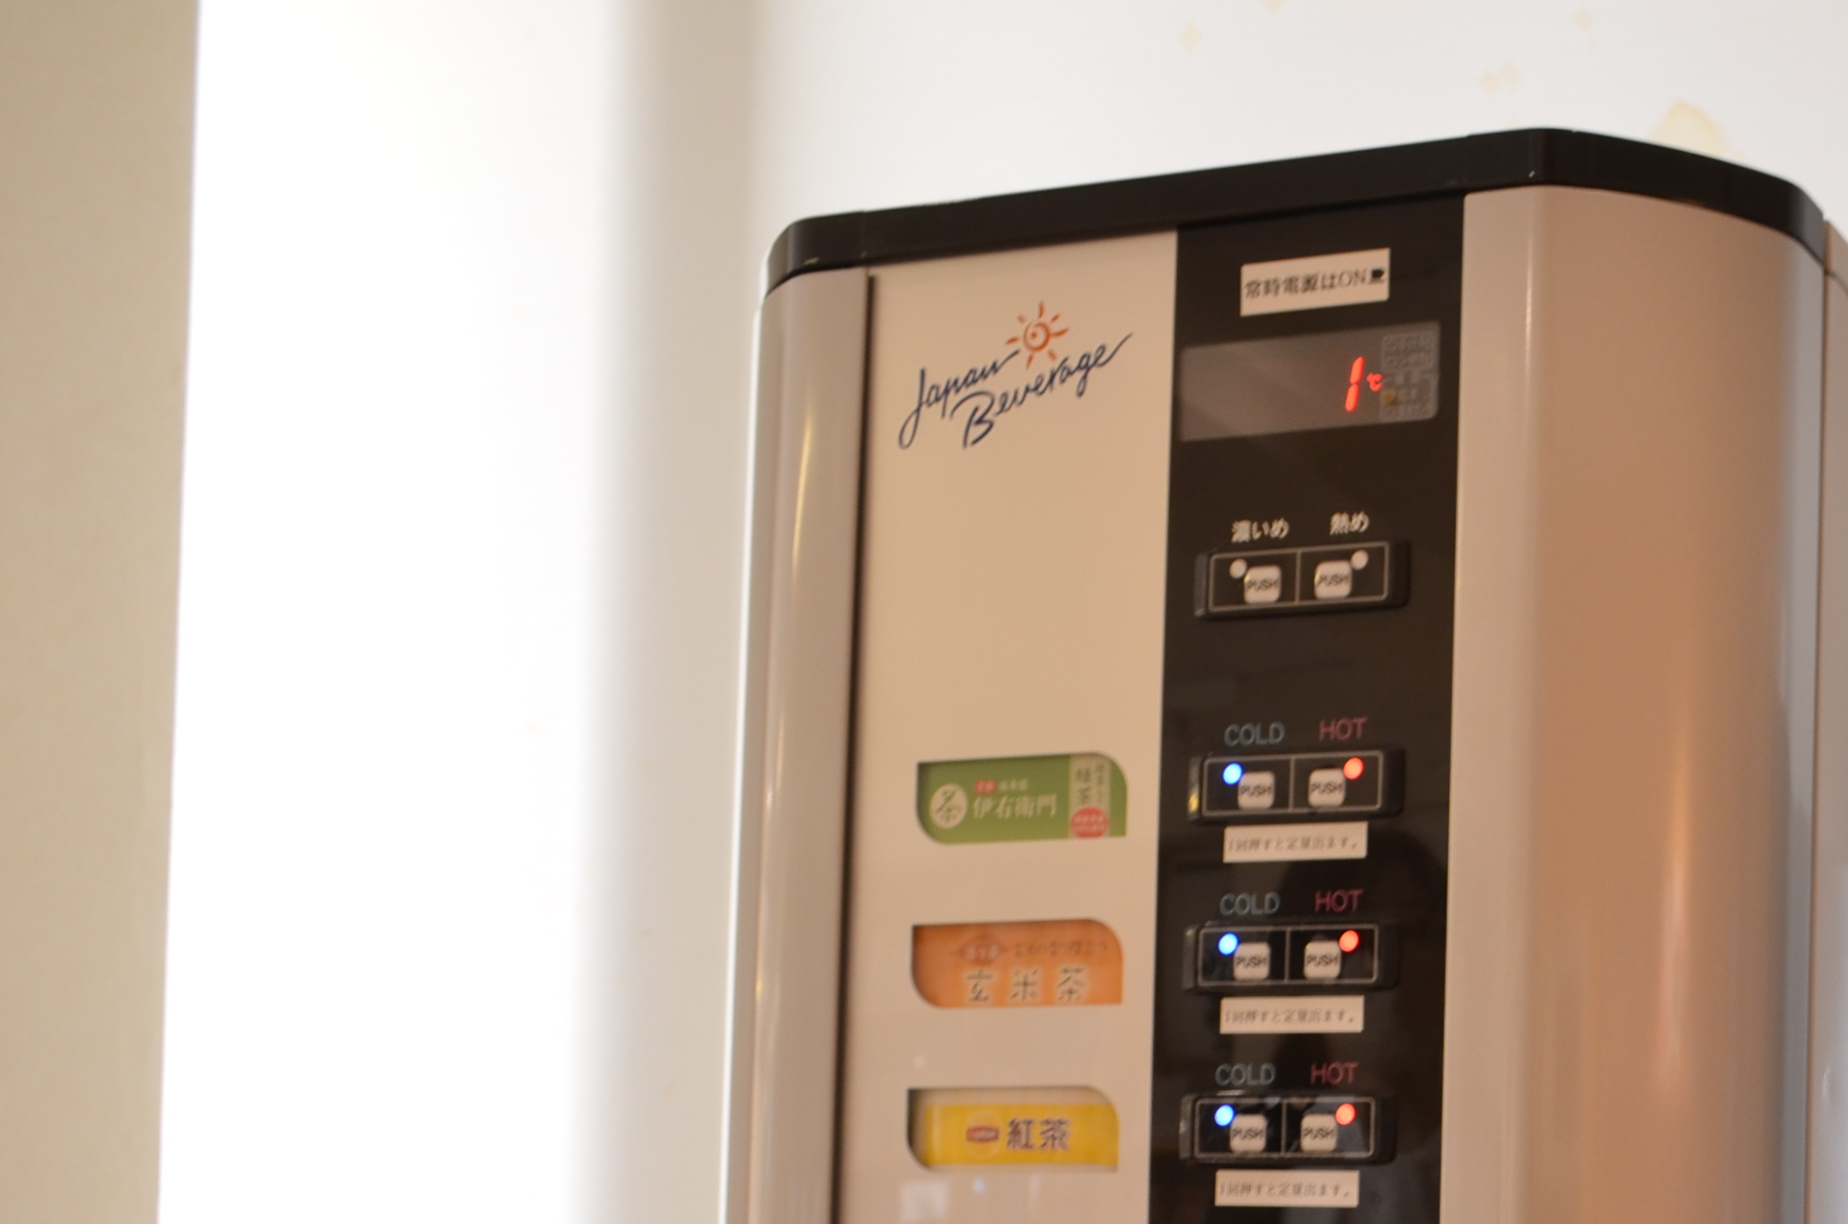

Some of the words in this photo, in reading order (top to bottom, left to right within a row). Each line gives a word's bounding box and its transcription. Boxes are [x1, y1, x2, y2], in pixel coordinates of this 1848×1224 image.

[950, 332, 1133, 449] Beverage
[899, 367, 1019, 449] Japan
[1224, 722, 1285, 746] COLD
[1319, 717, 1367, 741] HOT
[1240, 784, 1272, 796] PUSH
[1311, 782, 1342, 794] PUSH
[1219, 892, 1281, 916] COLD
[1314, 889, 1364, 912] HOT
[1236, 956, 1267, 968] PUSH
[1306, 955, 1338, 966] PUSH
[966, 965, 1086, 1002] 玄米茶
[1215, 1063, 1276, 1086] COLD
[1310, 1061, 1360, 1085] HOT
[1007, 1116, 1070, 1151] 紅茶
[1232, 1127, 1263, 1140] PUSH
[1303, 1127, 1334, 1140] PUSH
